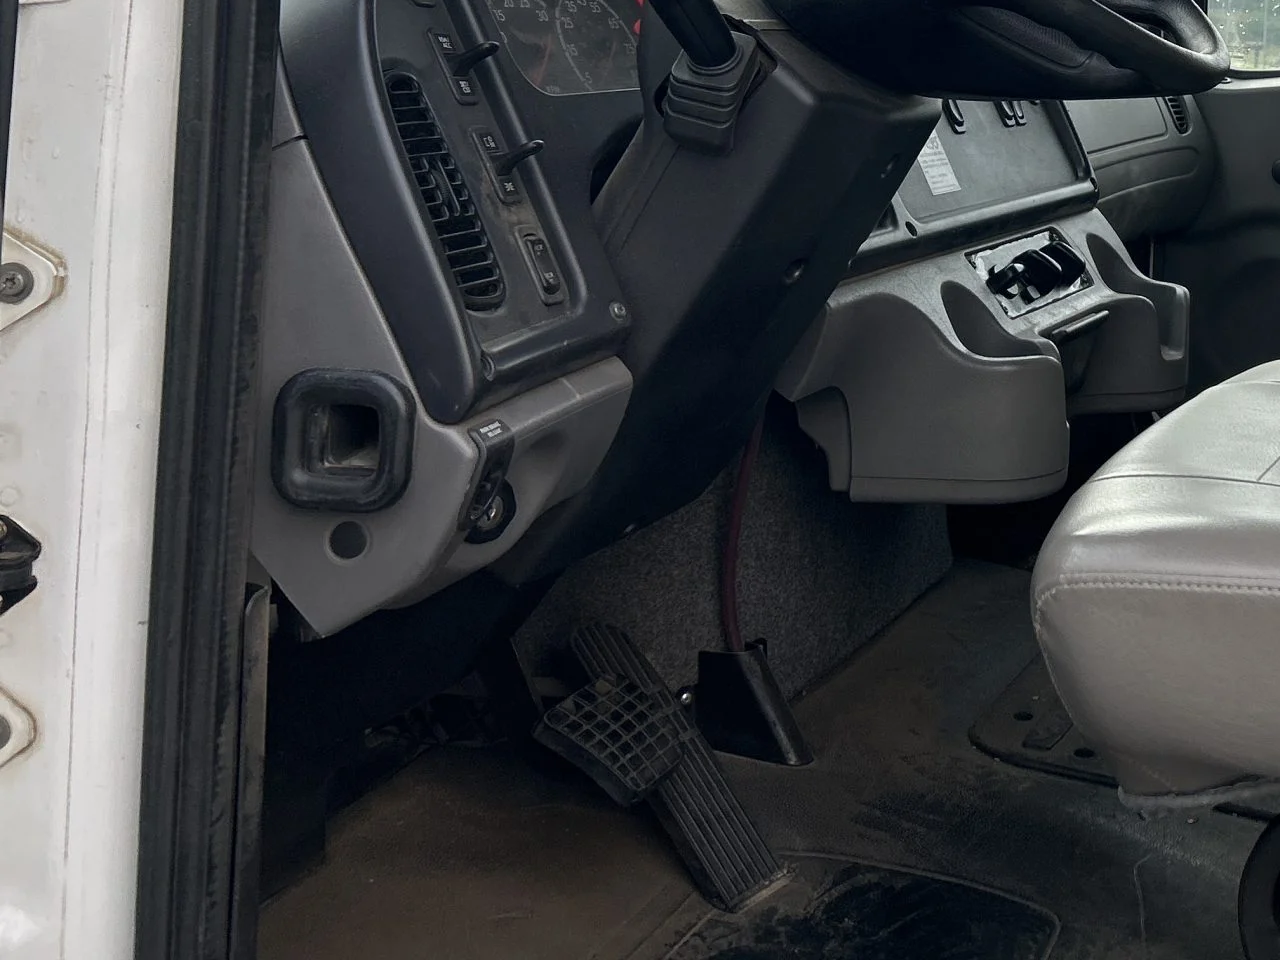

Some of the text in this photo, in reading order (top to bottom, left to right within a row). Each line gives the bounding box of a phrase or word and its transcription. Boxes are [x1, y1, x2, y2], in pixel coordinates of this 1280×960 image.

[566, 1, 577, 13] 35
[589, 2, 601, 13] 55
[535, 10, 549, 22] 30
[561, 17, 574, 29] 25
